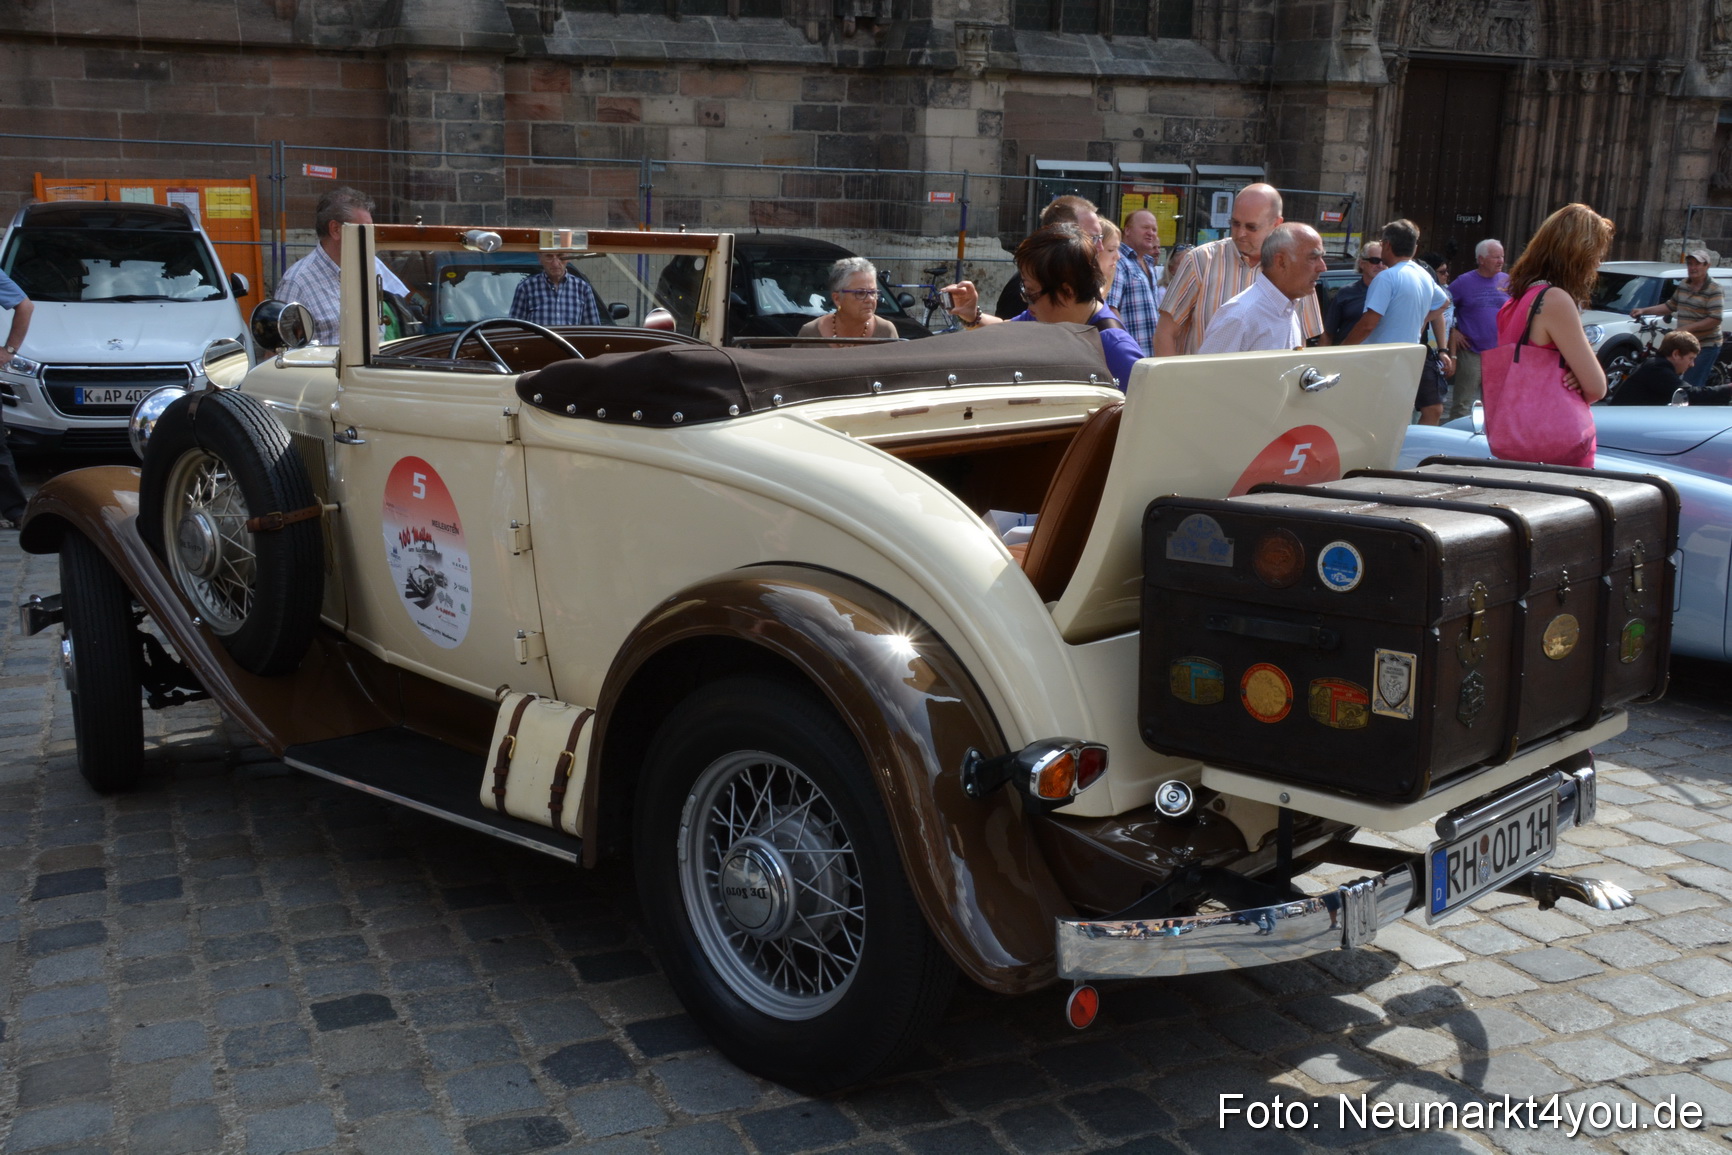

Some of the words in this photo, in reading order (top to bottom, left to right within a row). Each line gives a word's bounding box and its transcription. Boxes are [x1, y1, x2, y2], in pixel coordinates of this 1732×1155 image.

[1456, 213, 1476, 224] Eingang
[84, 389, 94, 403] K
[104, 389, 122, 403] AP
[1283, 442, 1312, 475] 5
[412, 472, 427, 500] 5
[431, 519, 460, 535] MEILENSTEIN
[398, 526, 411, 549] 100
[1447, 841, 1477, 899] RH
[1493, 820, 1521, 873] OD
[1526, 803, 1552, 857] 1H
[1436, 887, 1442, 901] D
